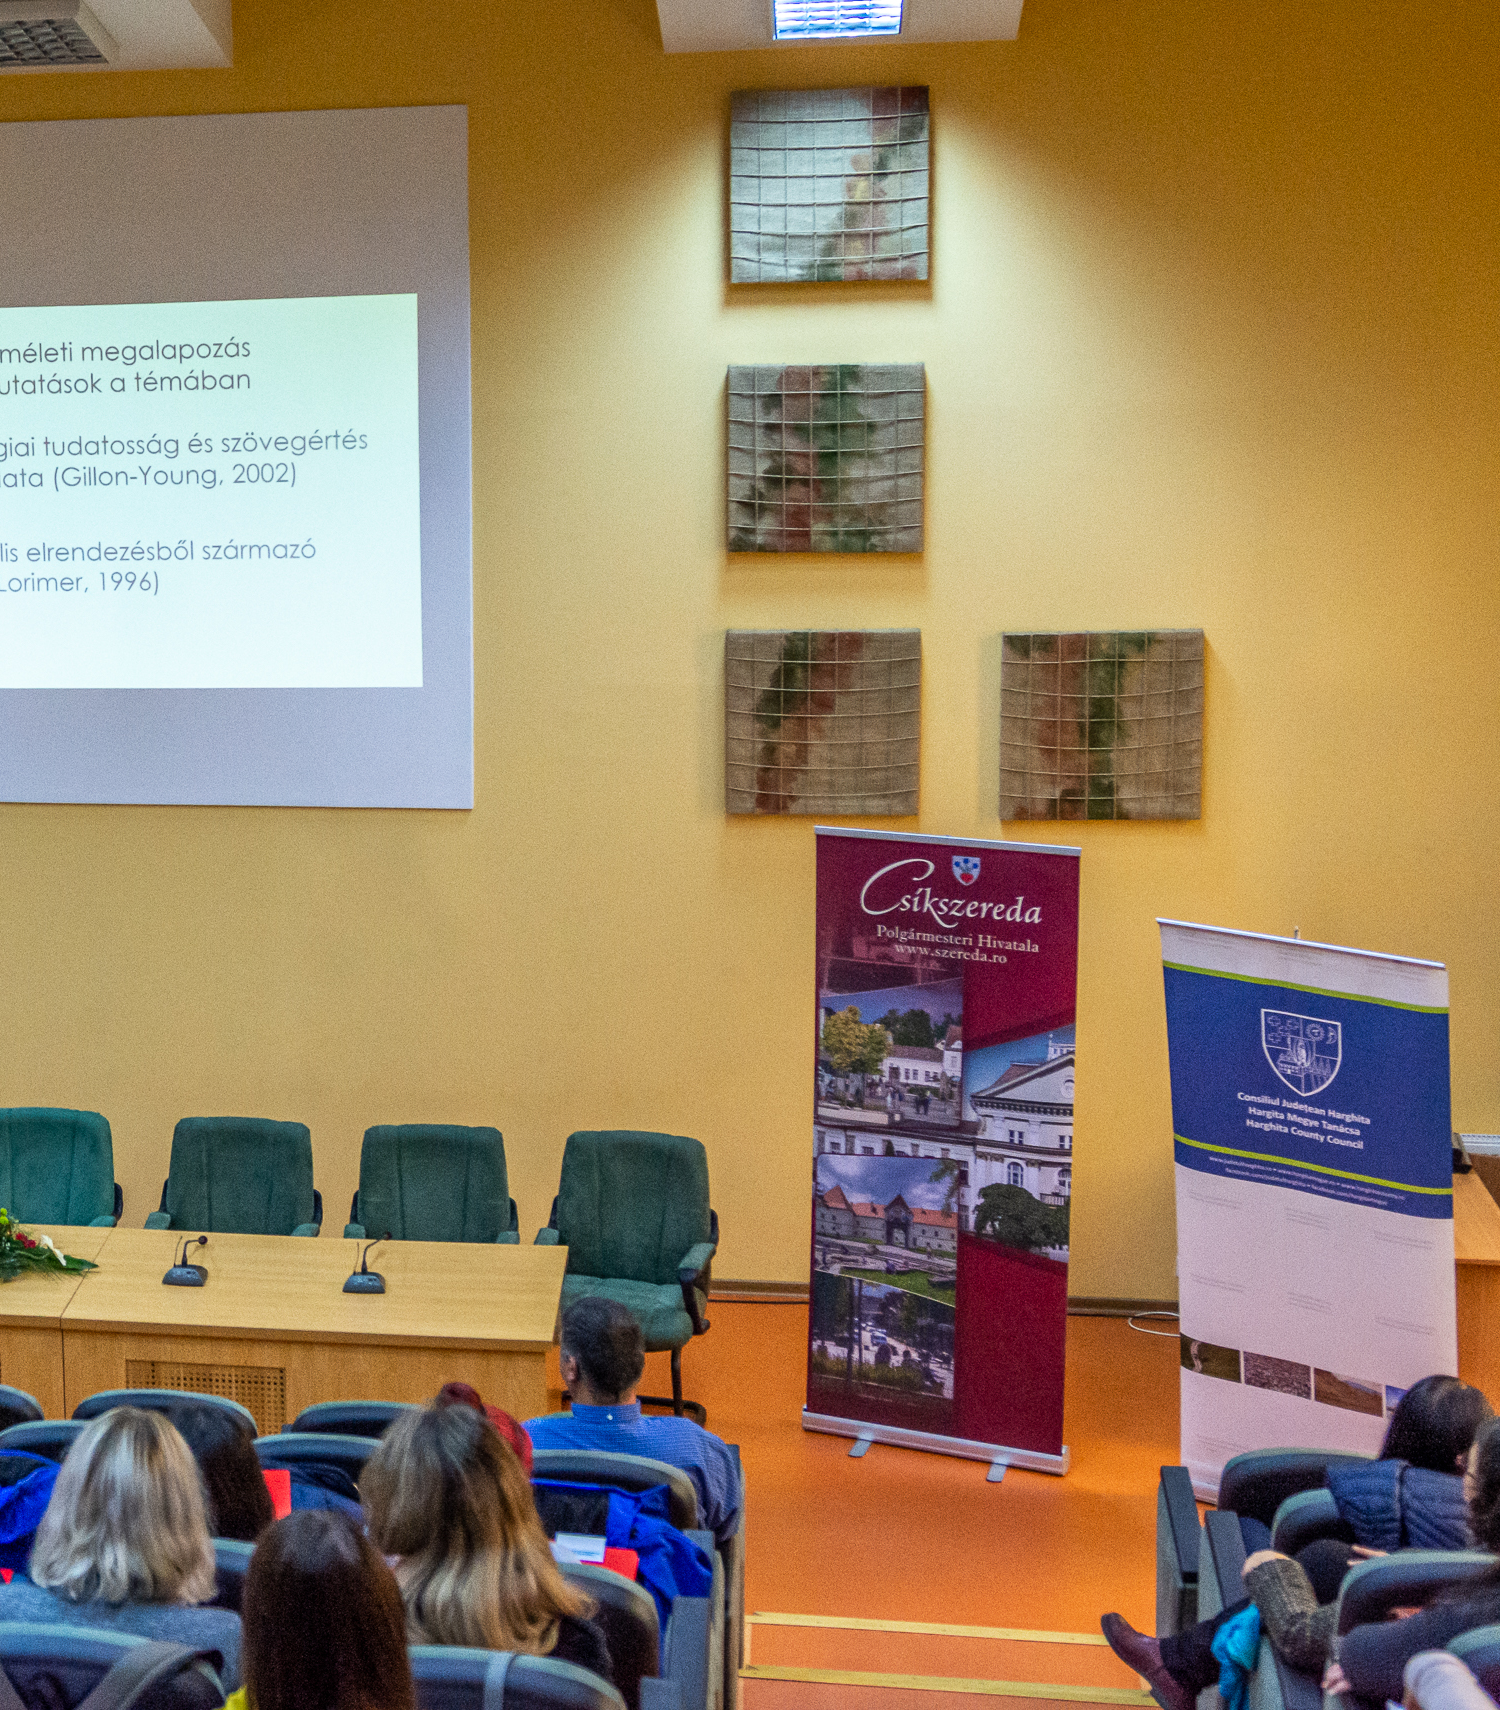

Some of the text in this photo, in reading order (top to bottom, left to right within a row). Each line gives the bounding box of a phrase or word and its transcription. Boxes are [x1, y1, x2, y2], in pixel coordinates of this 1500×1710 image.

[80, 336, 252, 369] megalapozás
[109, 377, 127, 394] a
[133, 368, 252, 393] témában
[43, 433, 180, 460] tudatosság
[187, 432, 214, 455] és
[220, 428, 369, 457] szövegértés
[53, 465, 224, 493] (Gillon-Young,
[231, 462, 297, 488] 2002)
[25, 539, 195, 563] elrendezésből
[201, 538, 317, 561] származó
[99, 571, 160, 597] 1996)
[860, 858, 1043, 929] Csíkszereda
[876, 924, 1040, 953] Polgármesteri Hivatala
[894, 944, 1008, 964] www.szereda.ro
[1237, 1091, 1280, 1107] Consiliul
[1328, 1109, 1371, 1125] Harghita
[1248, 1106, 1361, 1136] Hargita Megye Tanácsa
[1246, 1118, 1364, 1150] Harghita County Council
